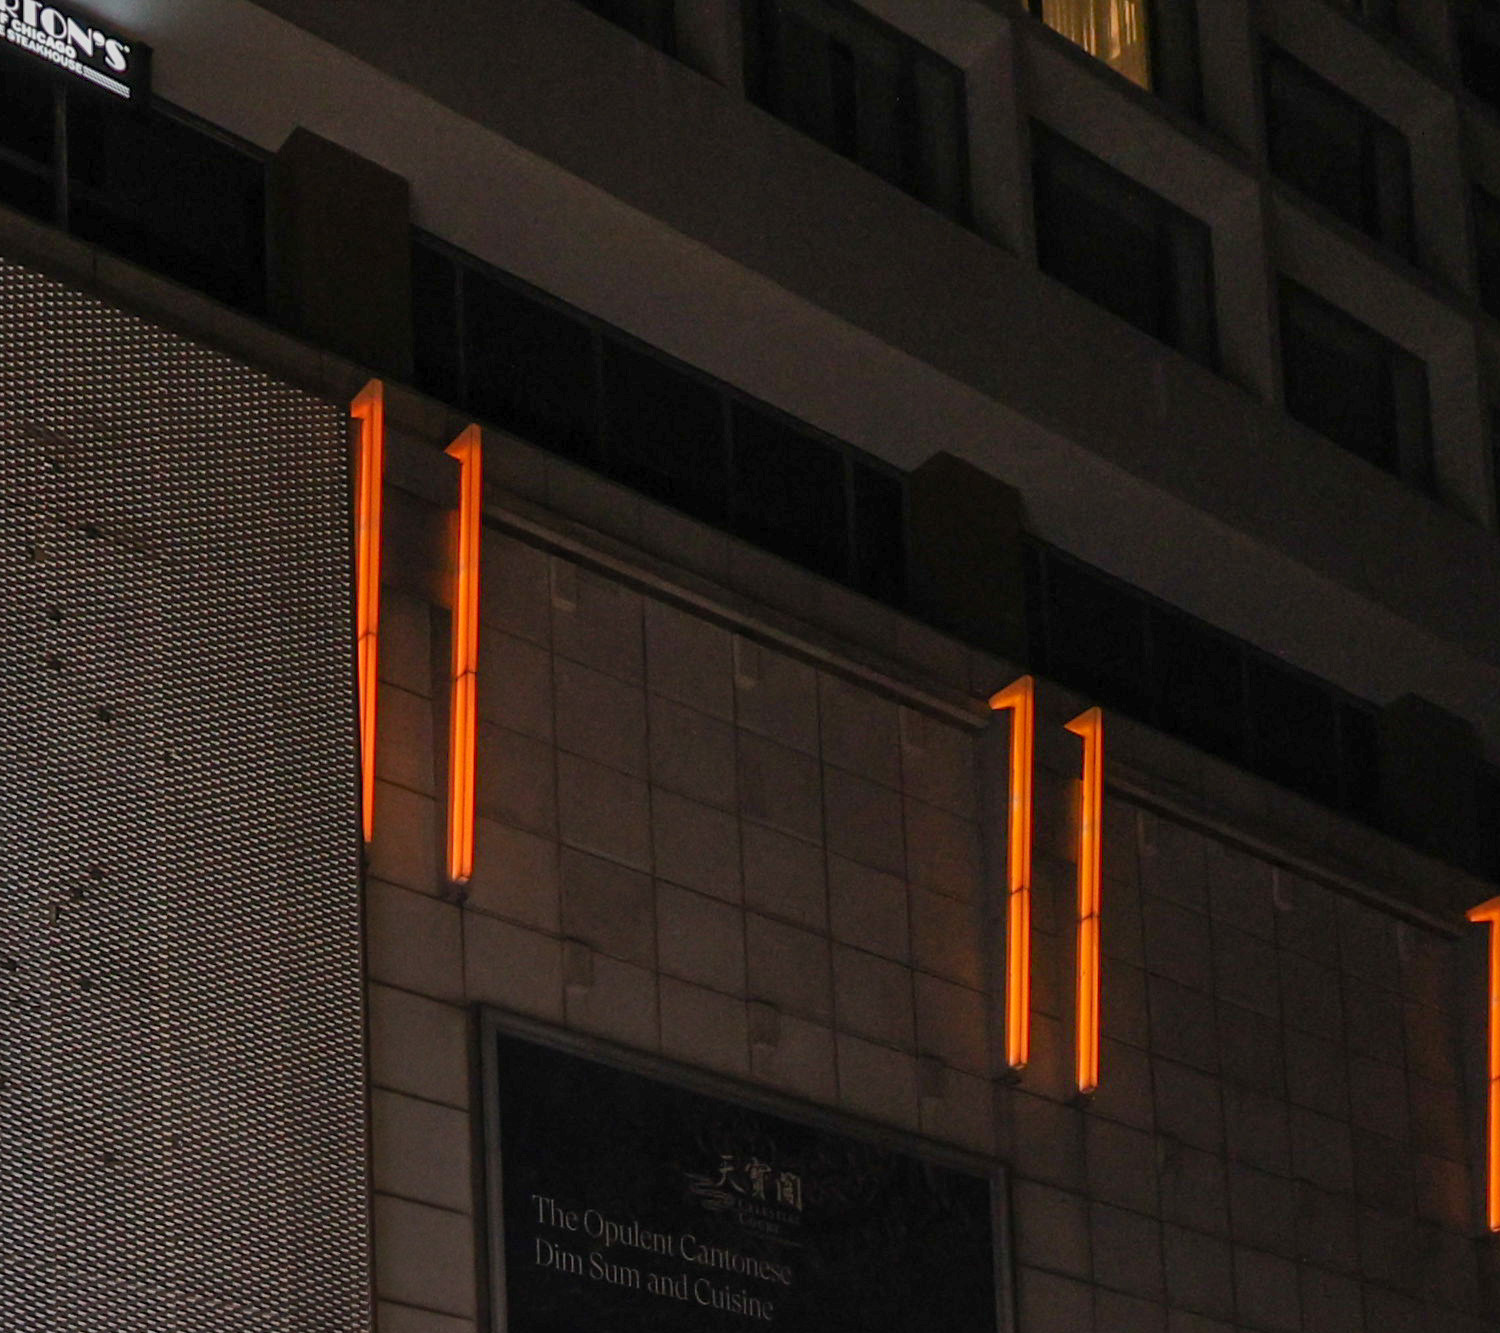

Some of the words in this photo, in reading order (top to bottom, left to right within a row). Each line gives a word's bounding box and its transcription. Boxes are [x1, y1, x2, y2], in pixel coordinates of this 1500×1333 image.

[6, 27, 84, 75] STEAKHOUSE
[10, 16, 77, 60] CHICAGO
[532, 1194, 577, 1231] The
[583, 1208, 675, 1256] Opulent
[680, 1233, 792, 1285] Cantonese
[535, 1237, 583, 1275] Dim
[589, 1252, 640, 1289] Sum
[647, 1272, 688, 1300] and
[694, 1277, 774, 1321] Cuisine
